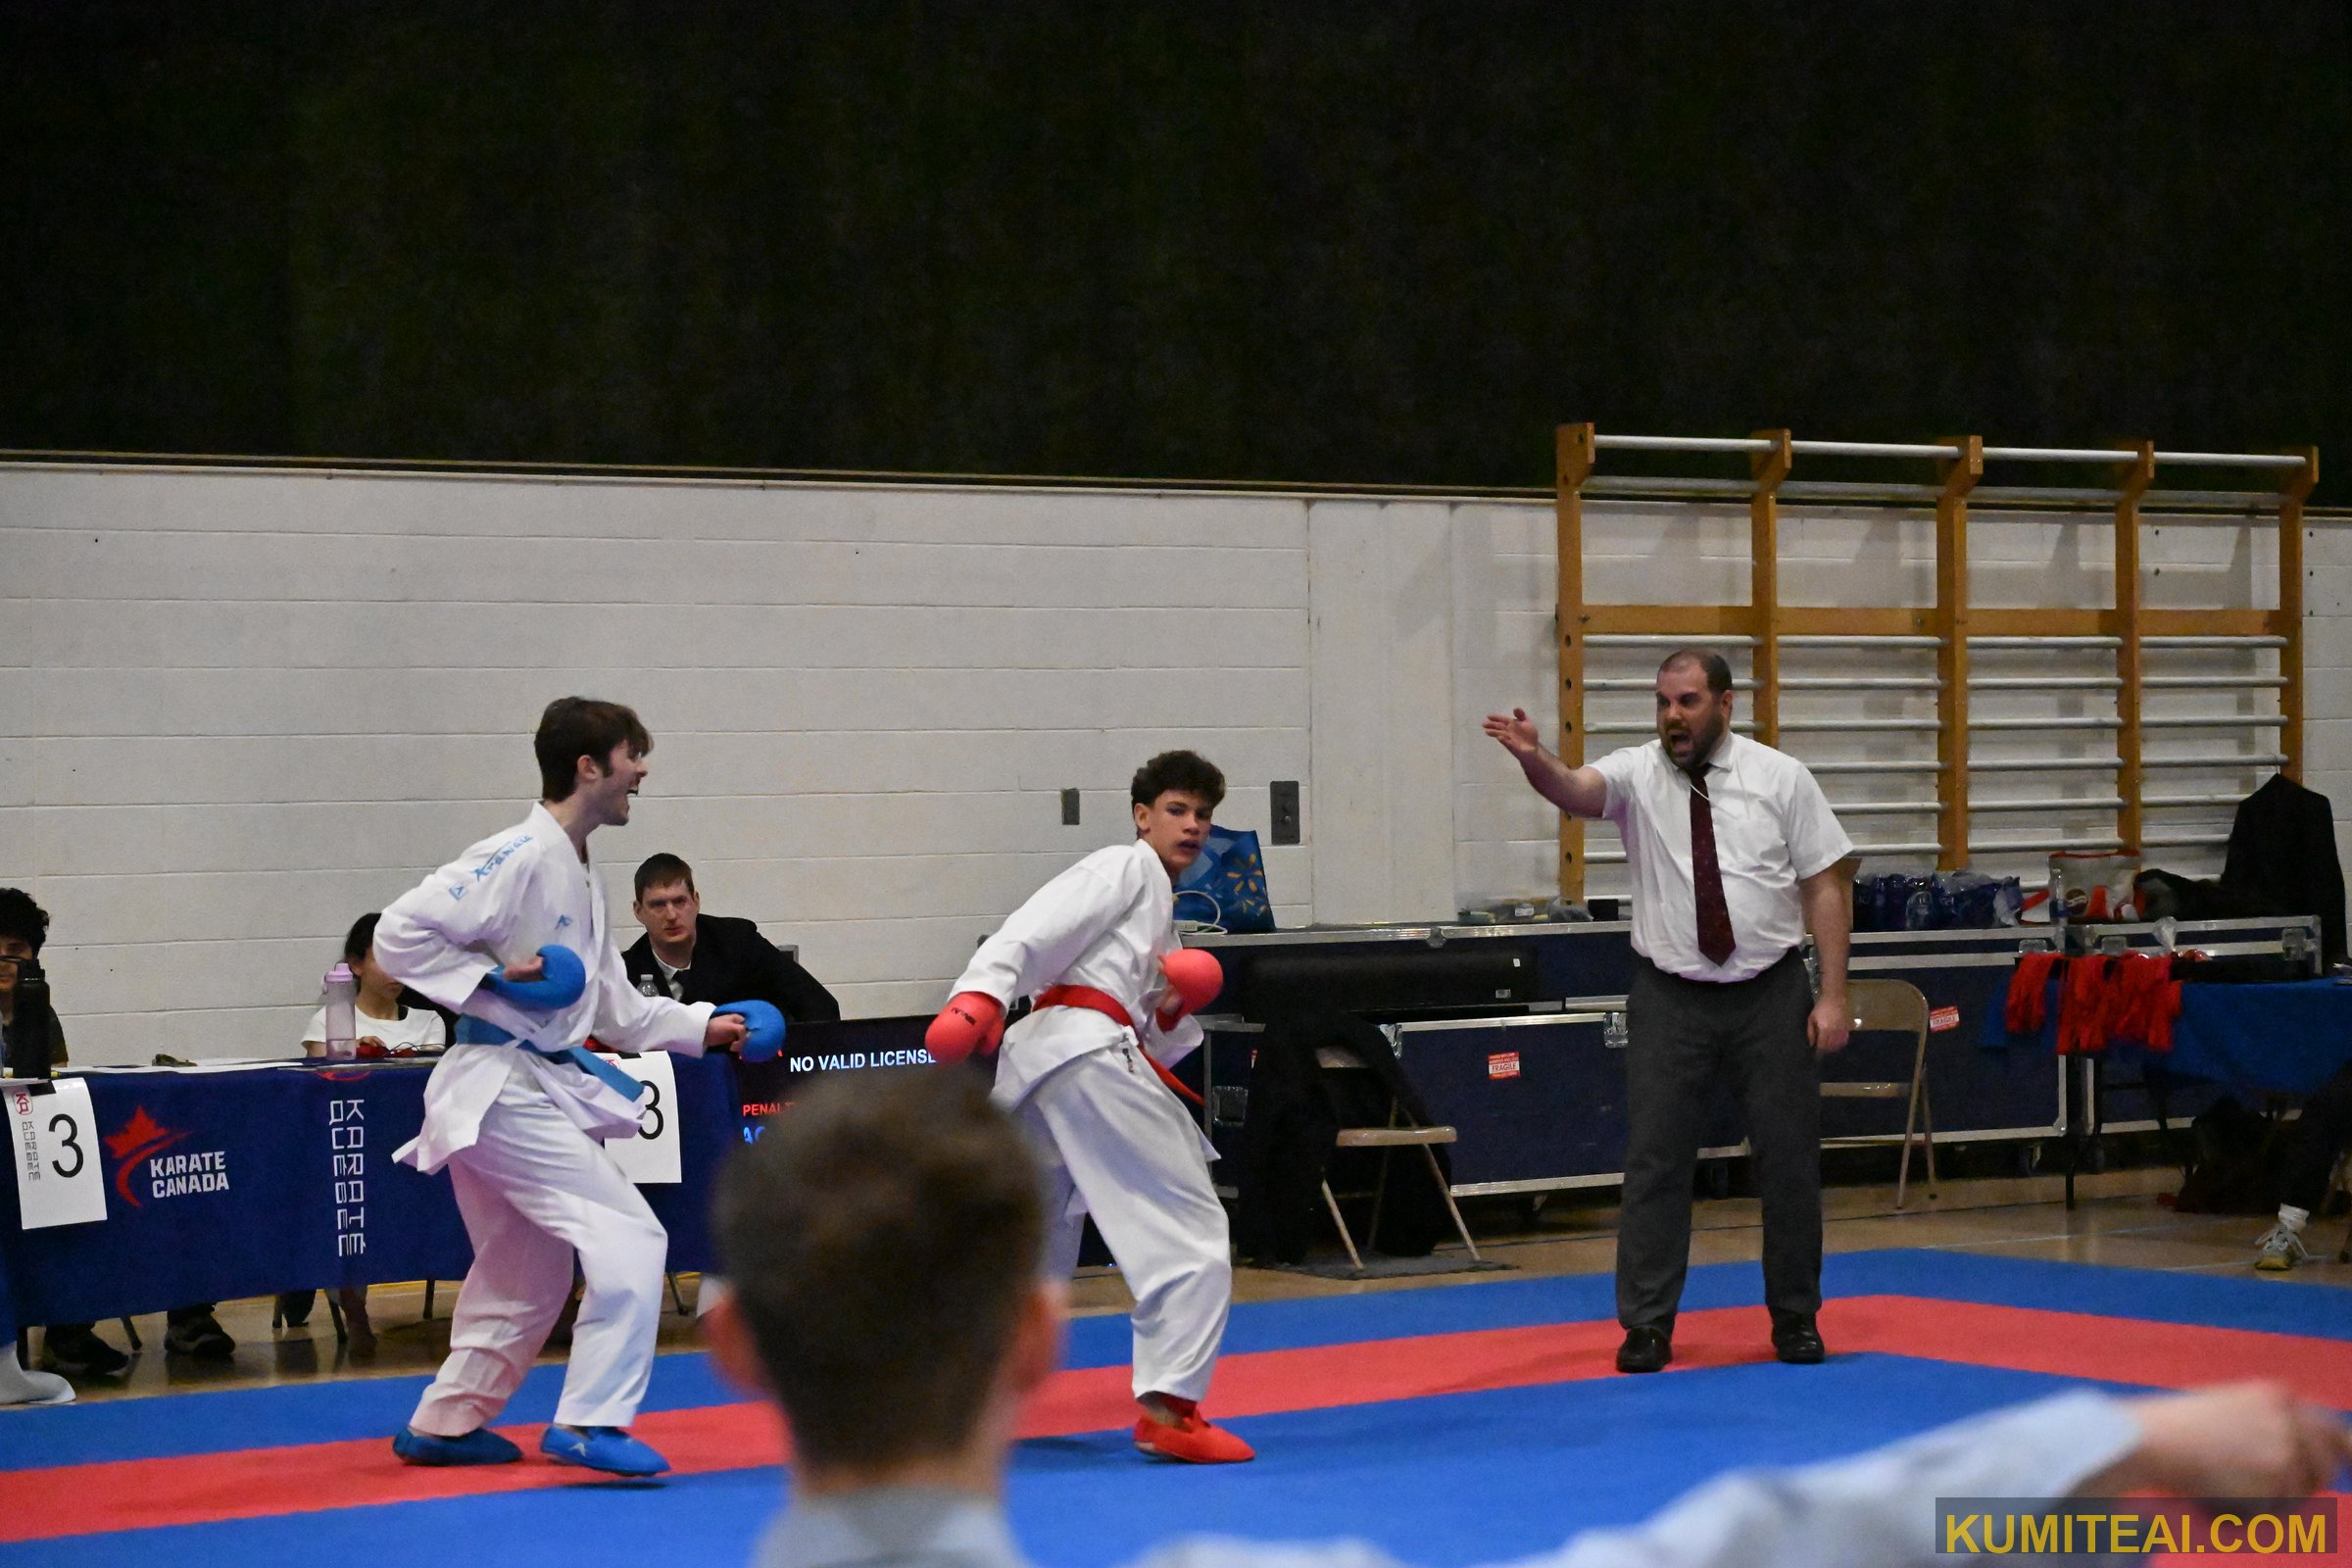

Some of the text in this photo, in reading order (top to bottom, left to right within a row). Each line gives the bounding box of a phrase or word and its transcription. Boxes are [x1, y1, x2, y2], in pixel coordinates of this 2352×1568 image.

[790, 1055, 814, 1073] NO
[817, 1053, 866, 1071] VALID
[1492, 1062, 1516, 1073] FRAGILE
[637, 1080, 664, 1140] 3
[743, 1101, 795, 1117] PENA
[48, 1113, 83, 1178] 3
[150, 1151, 226, 1178] KARATE
[152, 1172, 230, 1199] CANADA
